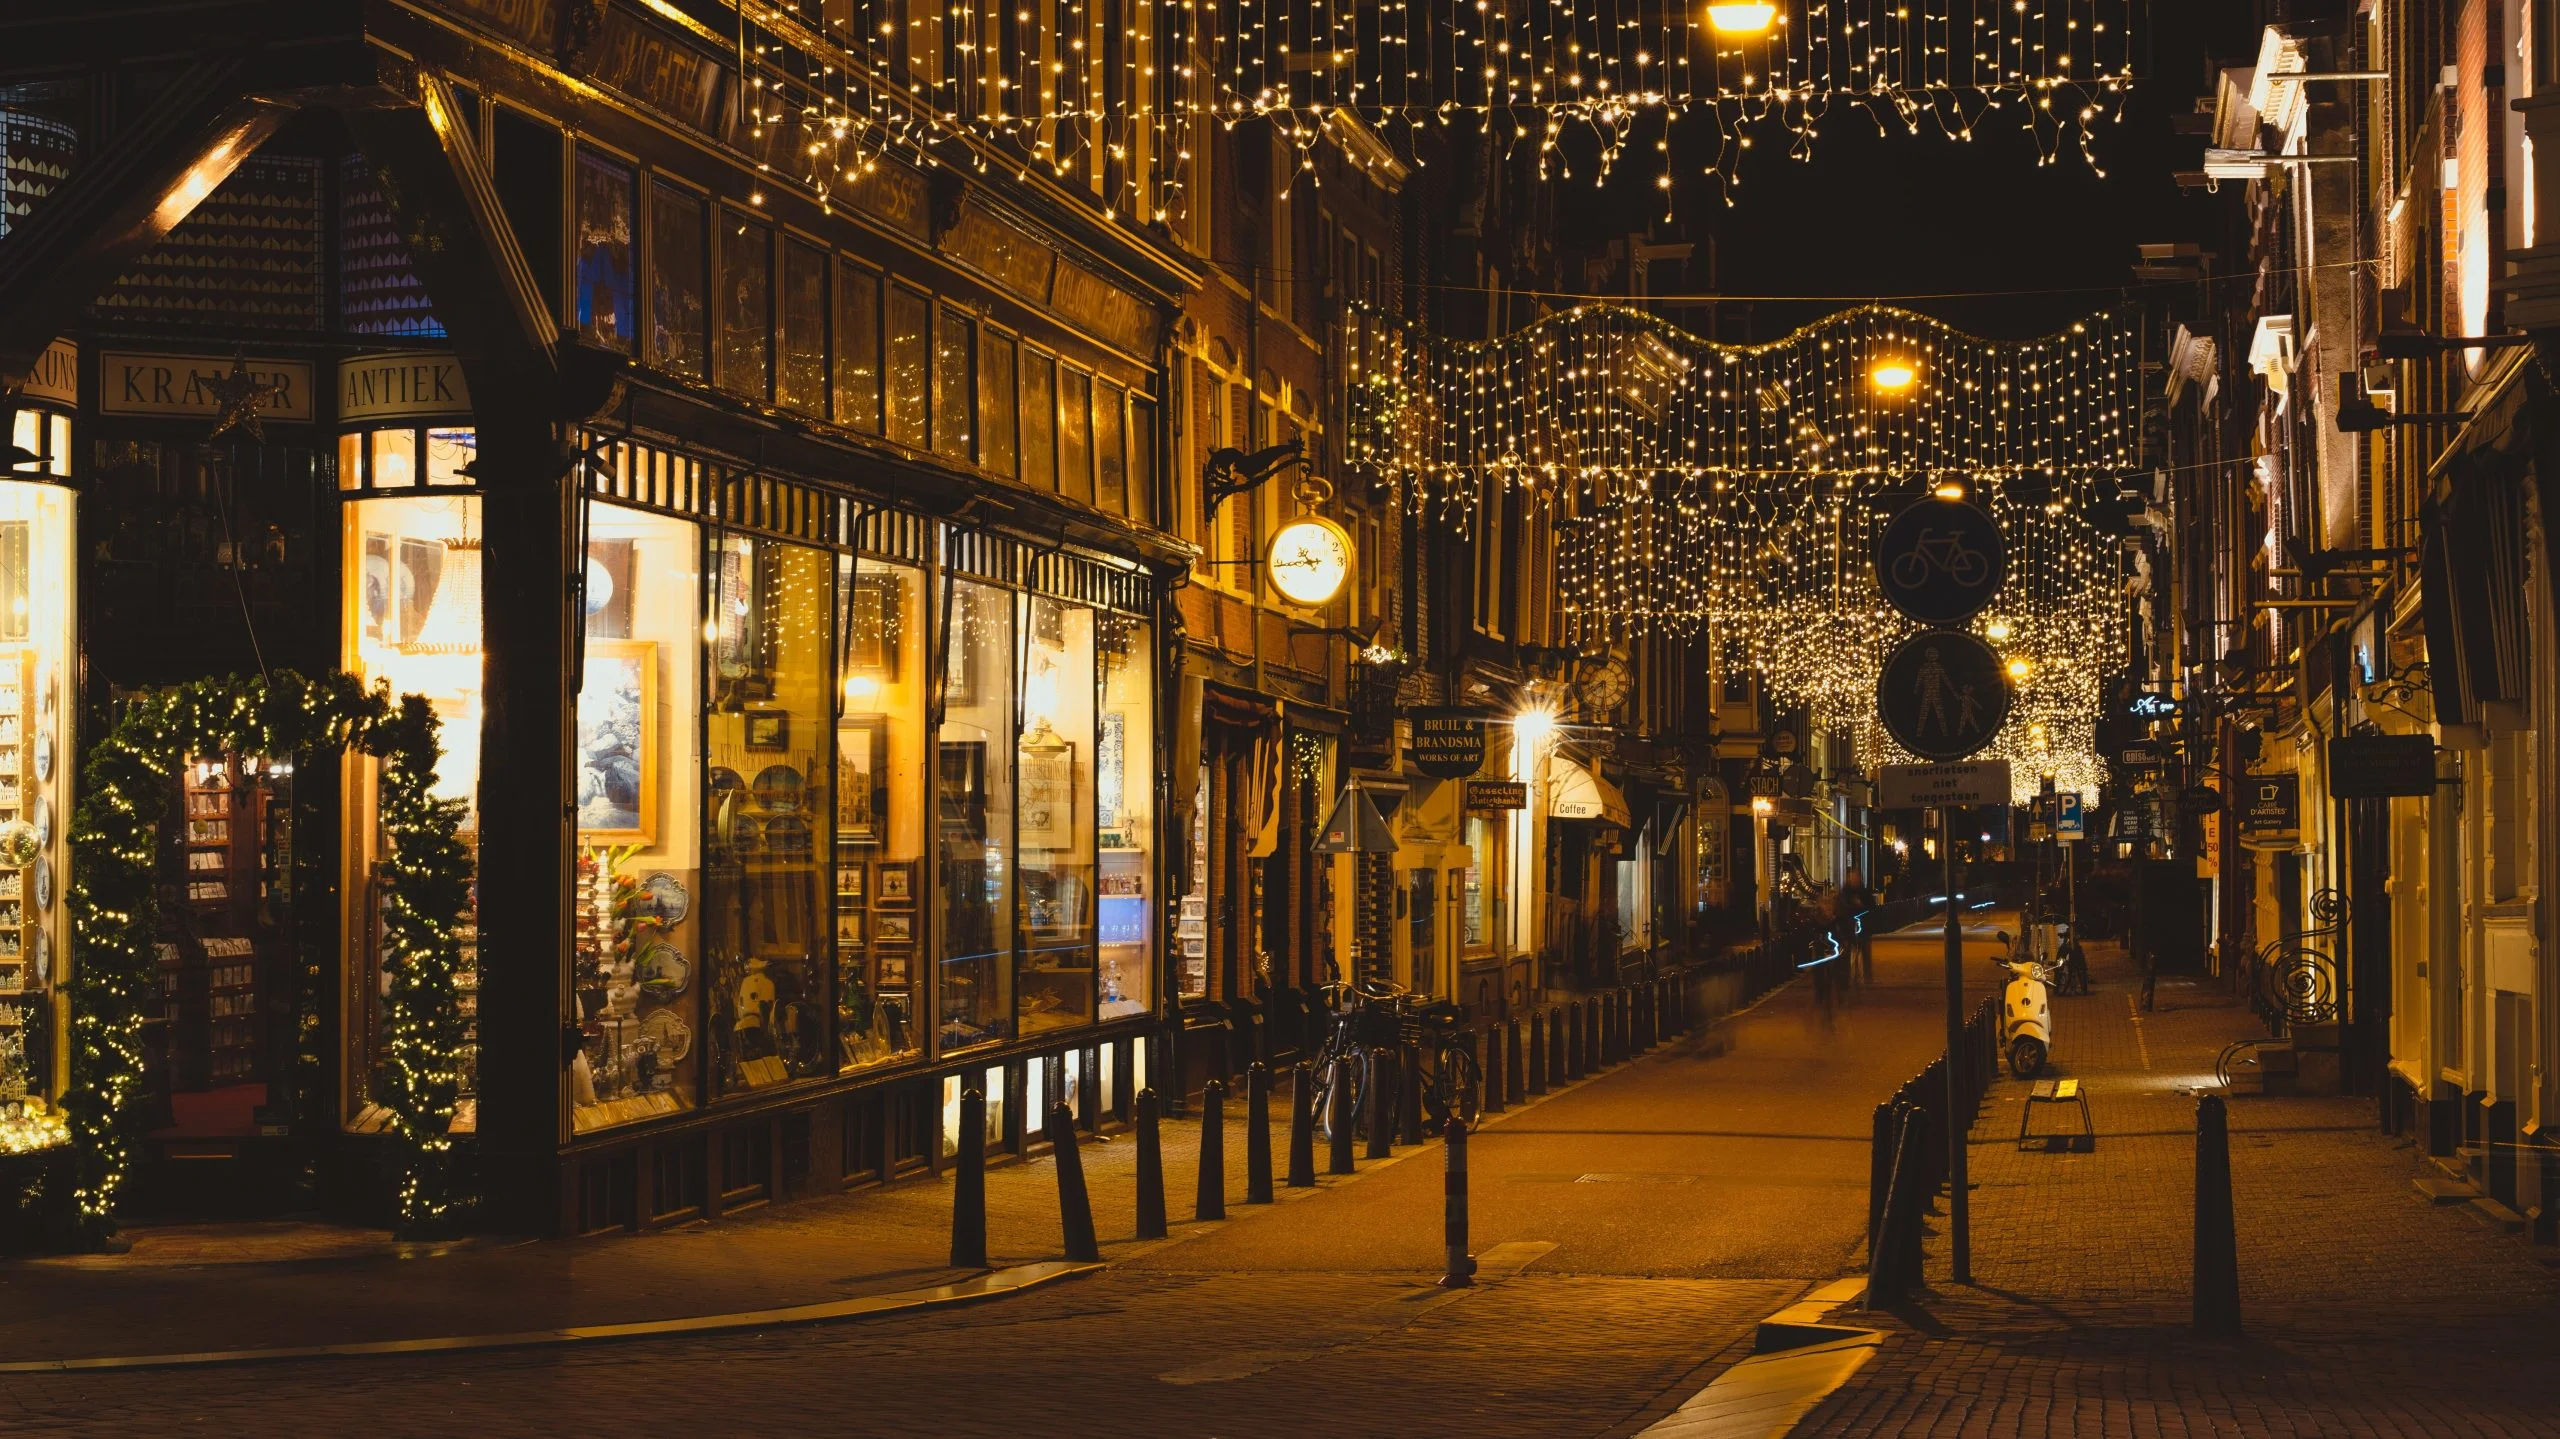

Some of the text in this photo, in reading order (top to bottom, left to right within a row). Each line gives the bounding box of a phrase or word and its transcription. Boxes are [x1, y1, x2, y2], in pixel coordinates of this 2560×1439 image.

[347, 364, 456, 408] ANTIEK
[1424, 719, 1474, 731] BRUIL &
[1416, 736, 1481, 748] BRANDSMA
[1418, 753, 1479, 762] WORKS OF ART
[1907, 765, 1978, 777] snorfietsen
[1750, 776, 1779, 794] STACH
[1933, 779, 1957, 788] niet
[1560, 803, 1586, 814] Coffee
[2062, 796, 2077, 816] P
